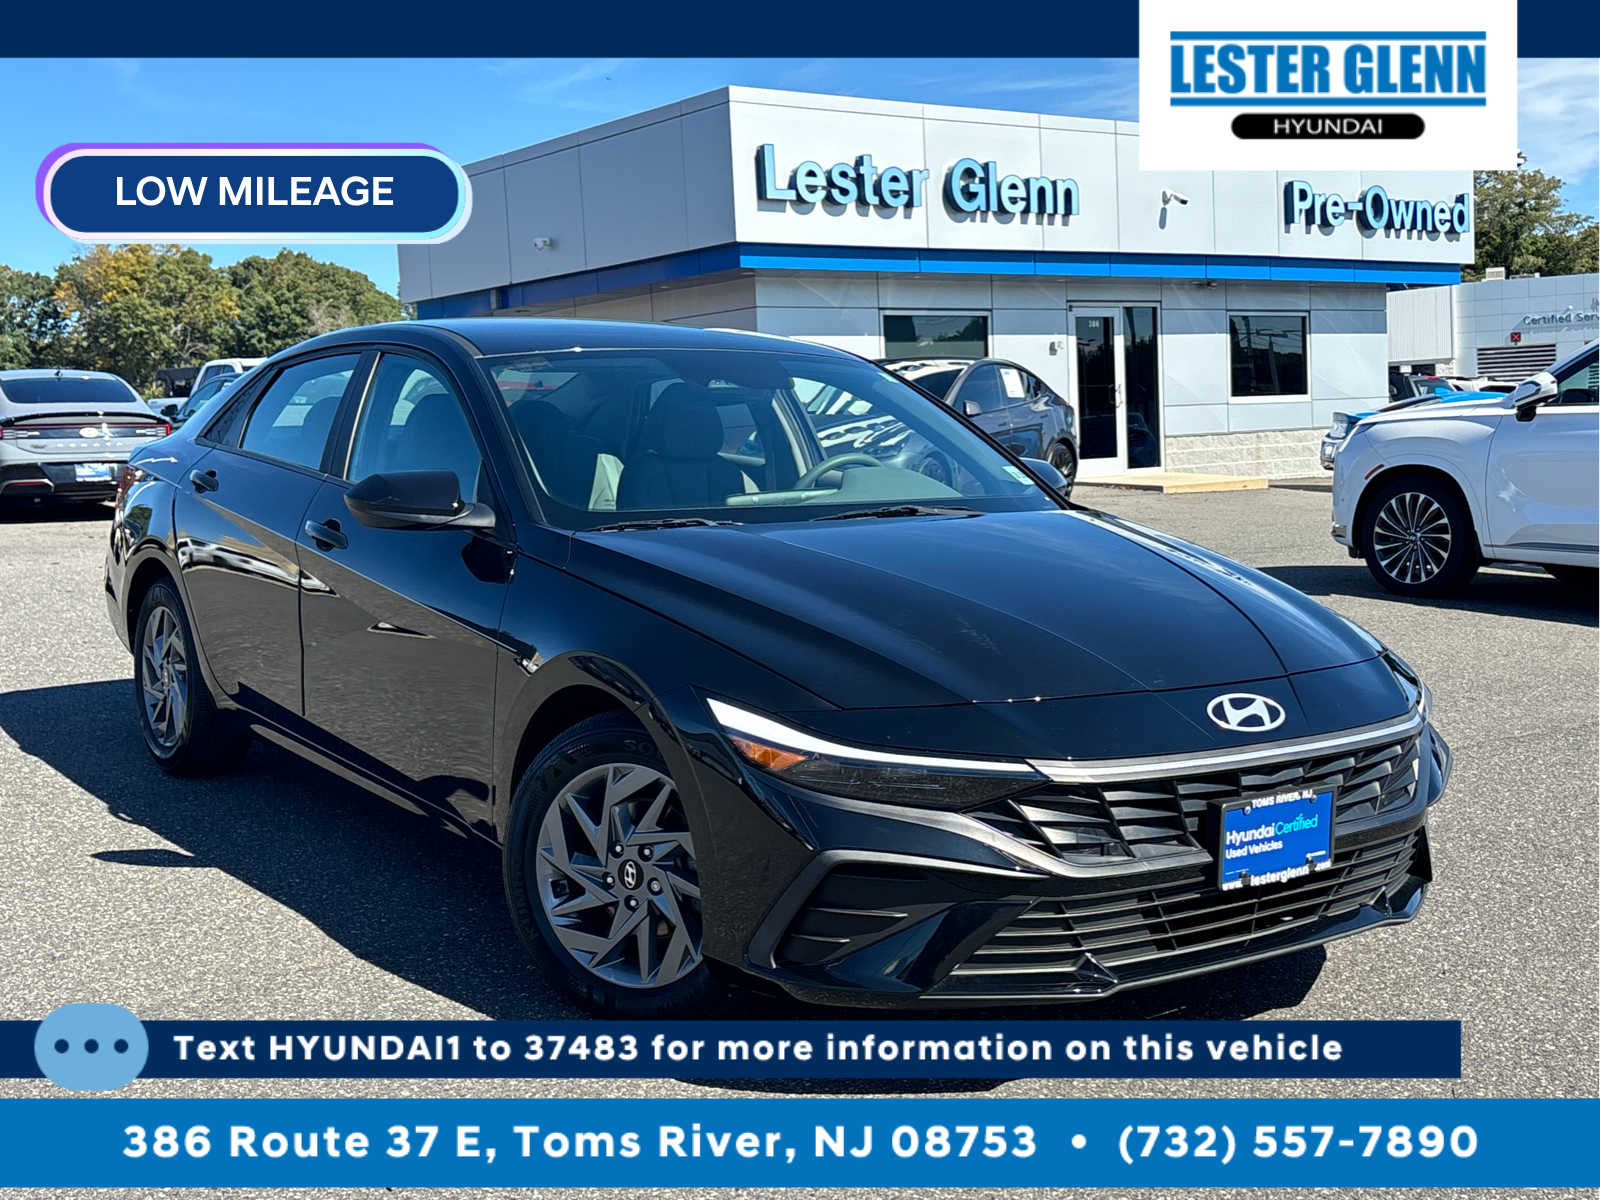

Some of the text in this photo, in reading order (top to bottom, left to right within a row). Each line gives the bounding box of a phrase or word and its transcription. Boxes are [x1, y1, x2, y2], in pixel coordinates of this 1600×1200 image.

[755, 143, 1080, 216] Lester Glenn
[1284, 180, 1470, 233] Pre-Owned
[1523, 313, 1572, 326] Certified
[1225, 814, 1318, 846] Hyundai Certified
[1225, 840, 1283, 859] Used Vehicles
